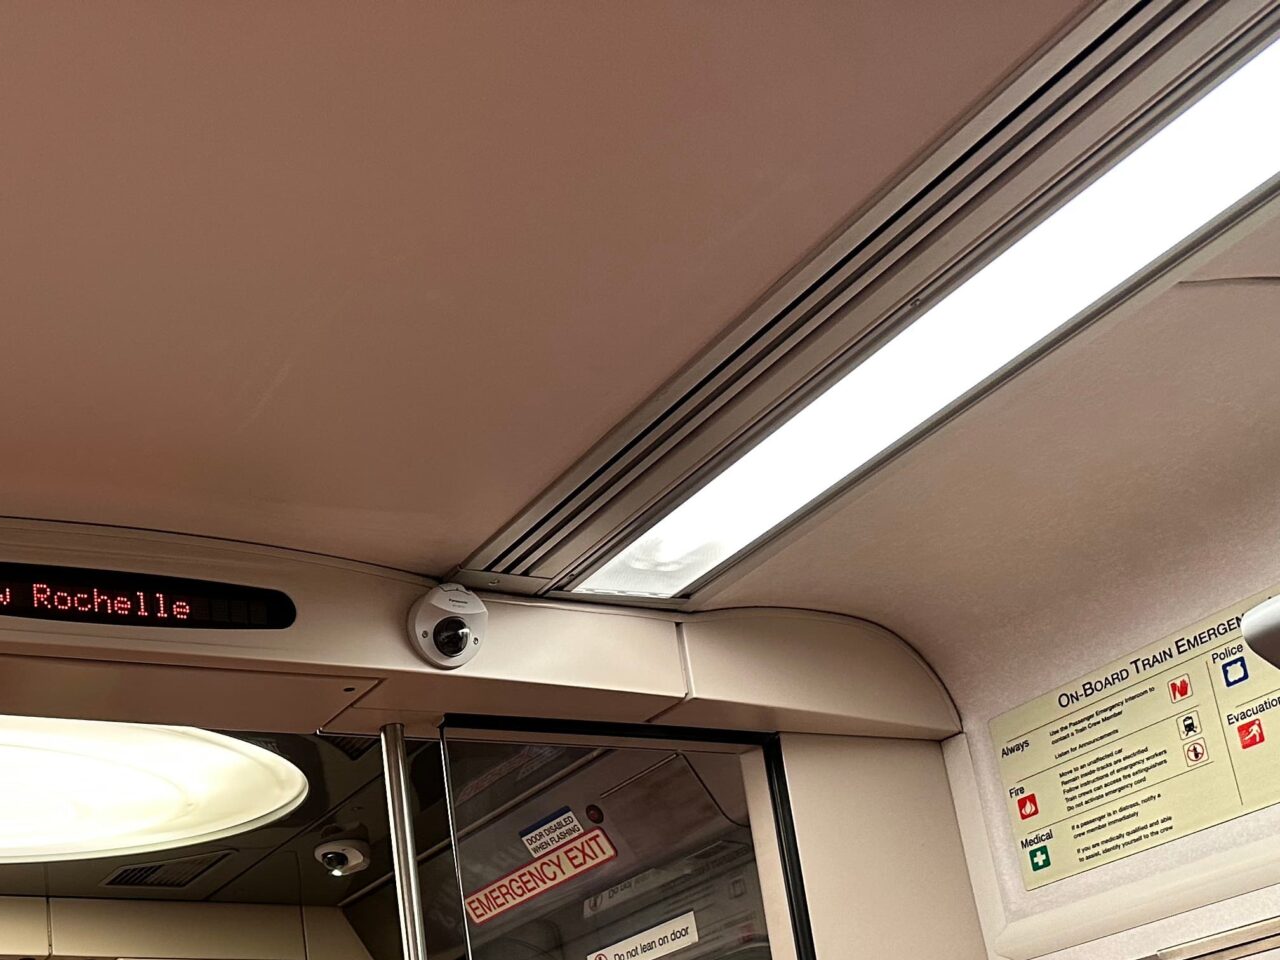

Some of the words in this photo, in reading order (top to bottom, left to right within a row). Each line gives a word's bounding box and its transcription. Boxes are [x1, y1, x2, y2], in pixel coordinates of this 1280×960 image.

[33, 583, 190, 618] Rochelle
[1174, 613, 1244, 655] EMERGEN
[1212, 644, 1243, 664] Police
[1095, 701, 1124, 716] Emergency
[1102, 711, 1122, 722] Member
[1001, 740, 1030, 758] Always
[1078, 729, 1119, 749] Announcements
[1009, 786, 1025, 798] Fire
[526, 831, 545, 846] DOOR
[543, 815, 574, 837] DISABLED
[531, 841, 551, 854] WHEN
[550, 824, 581, 845] FLASHING
[1020, 829, 1054, 849] Medical
[466, 855, 566, 919] EMERGENCY
[564, 833, 607, 870] EXIT
[626, 947, 640, 960] not
[639, 940, 657, 955] lean
[658, 934, 669, 946] on
[670, 925, 690, 942] door
